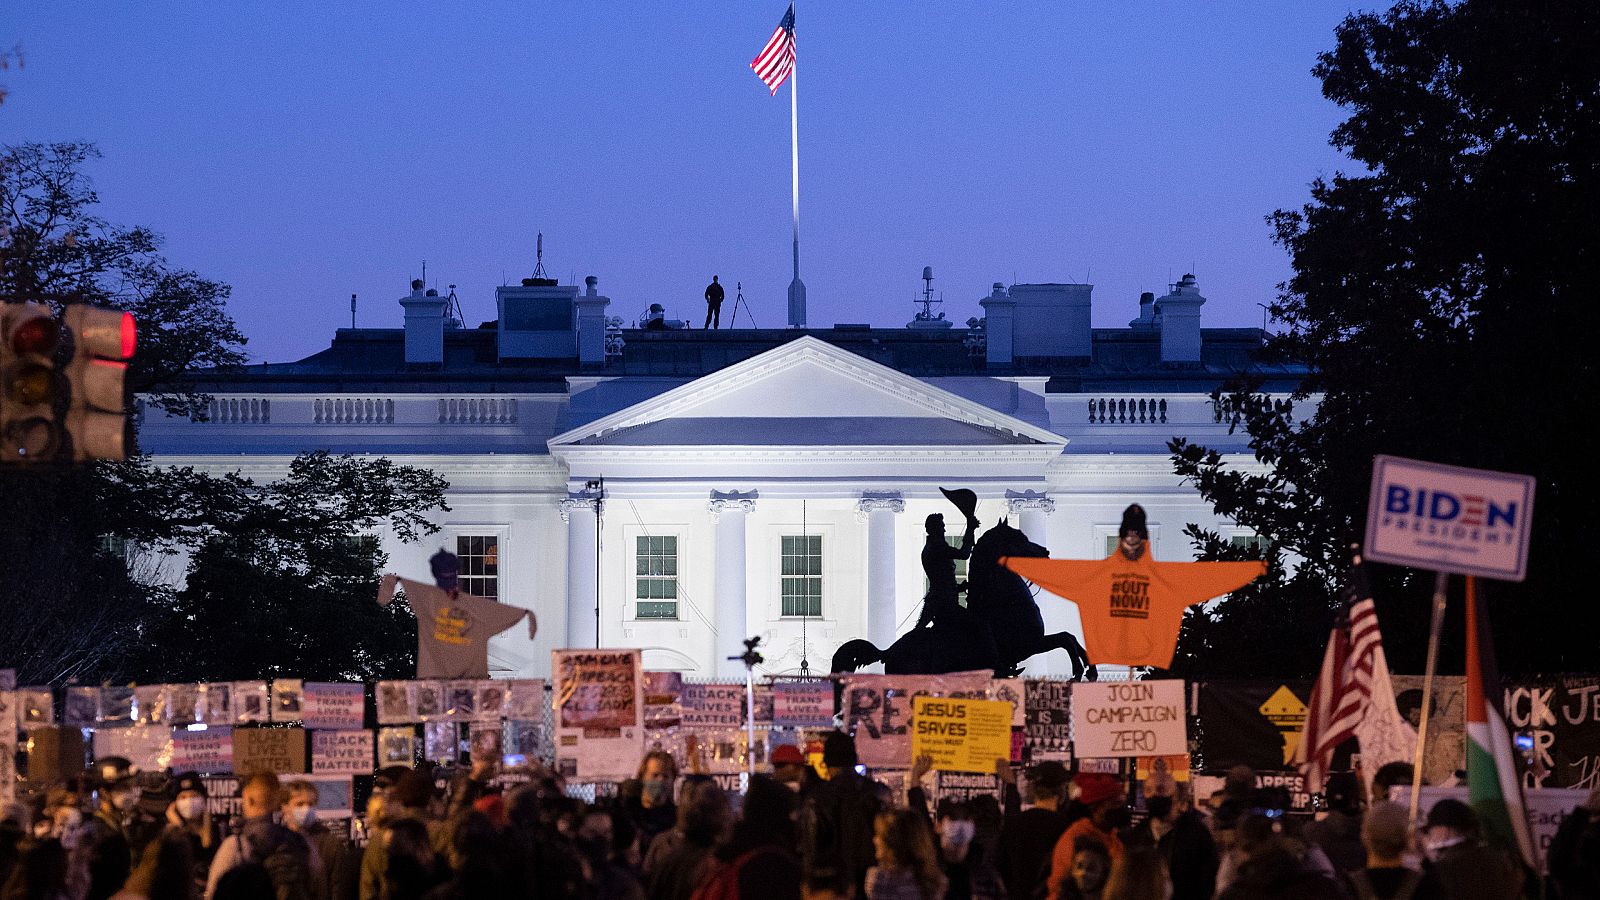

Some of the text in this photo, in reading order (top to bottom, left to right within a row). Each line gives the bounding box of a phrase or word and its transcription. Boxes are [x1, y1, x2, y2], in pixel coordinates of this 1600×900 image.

[1386, 483, 1516, 528] BIDEN
[1112, 580, 1150, 596] #OUT
[1110, 595, 1150, 610] NOW!
[688, 689, 737, 699] BLACK
[1025, 682, 1069, 699] WHITE
[1108, 684, 1154, 702] JOIN
[316, 698, 353, 706] TRANS
[786, 695, 822, 703] TRANS
[317, 708, 350, 716] LIVES
[694, 702, 732, 712] LIVES
[787, 705, 820, 713] LIVES
[918, 702, 967, 719] JESUS
[313, 716, 356, 724] MATTER
[683, 714, 738, 724] MATTER
[1038, 710, 1052, 724] IS
[1086, 705, 1177, 724] CAMPAIGN
[917, 720, 968, 737] SAVES
[248, 730, 289, 743] BLACK
[319, 736, 367, 746] BLACK
[1110, 730, 1157, 752] ZERO
[185, 752, 219, 760] LIVES
[247, 743, 287, 756] LIVES
[325, 748, 363, 758] LIVES
[180, 761, 226, 770] MATTER
[242, 757, 292, 770] MATTER
[315, 761, 369, 770] MATTER
[203, 779, 240, 797] UMP
